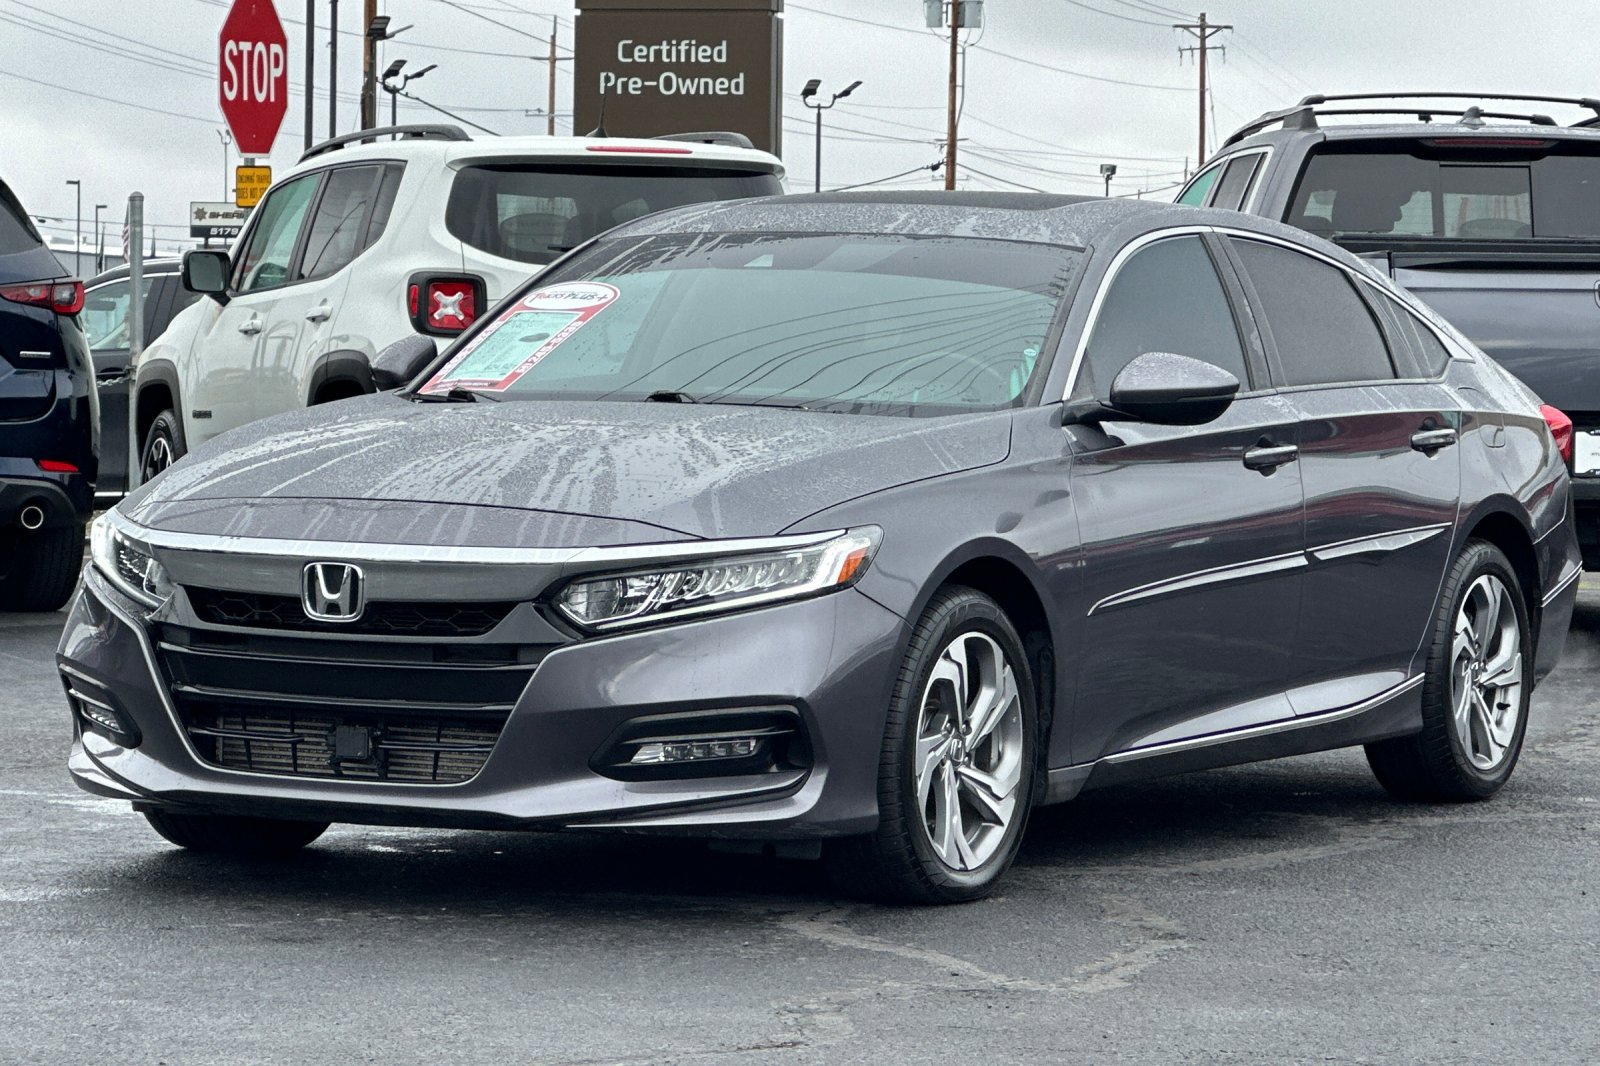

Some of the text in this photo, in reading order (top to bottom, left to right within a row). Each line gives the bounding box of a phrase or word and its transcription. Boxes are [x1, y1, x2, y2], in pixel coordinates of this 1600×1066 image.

[617, 39, 727, 63] Certified
[223, 40, 285, 102] STOP
[599, 71, 745, 96] Pre-Owned
[208, 211, 244, 219] SHERI
[209, 227, 239, 235] 5179
